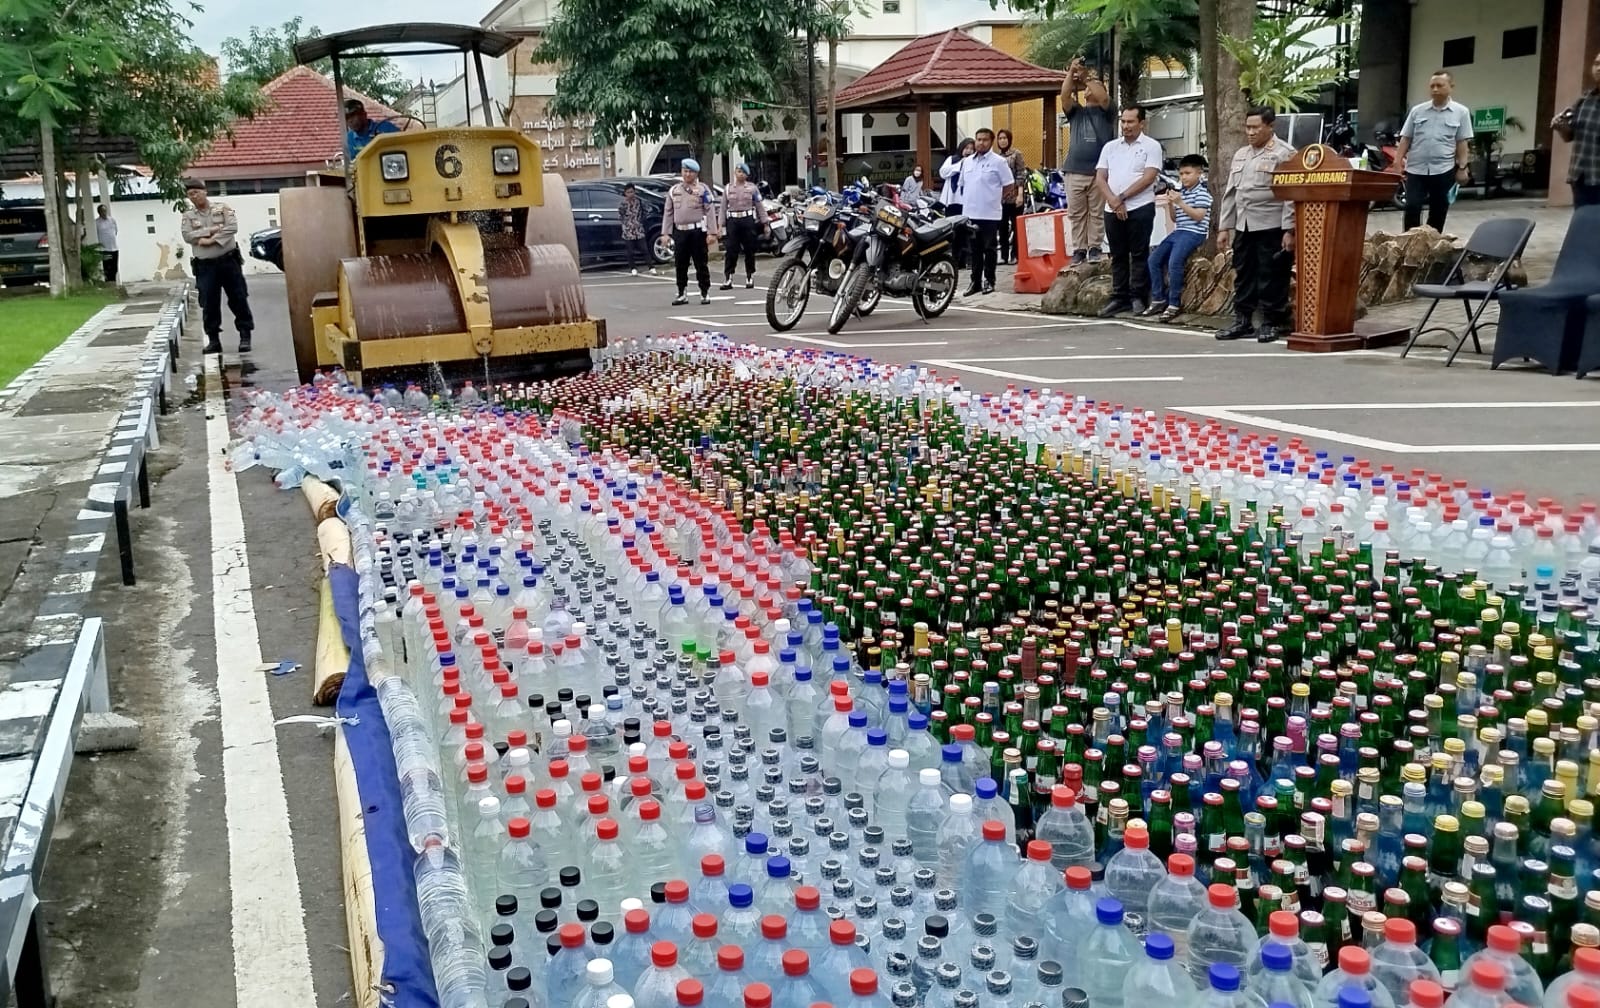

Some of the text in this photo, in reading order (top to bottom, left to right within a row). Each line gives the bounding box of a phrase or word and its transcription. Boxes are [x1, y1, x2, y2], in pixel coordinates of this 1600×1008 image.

[435, 144, 463, 179] 6
[1273, 171, 1347, 185] POLRES JOMBANG
